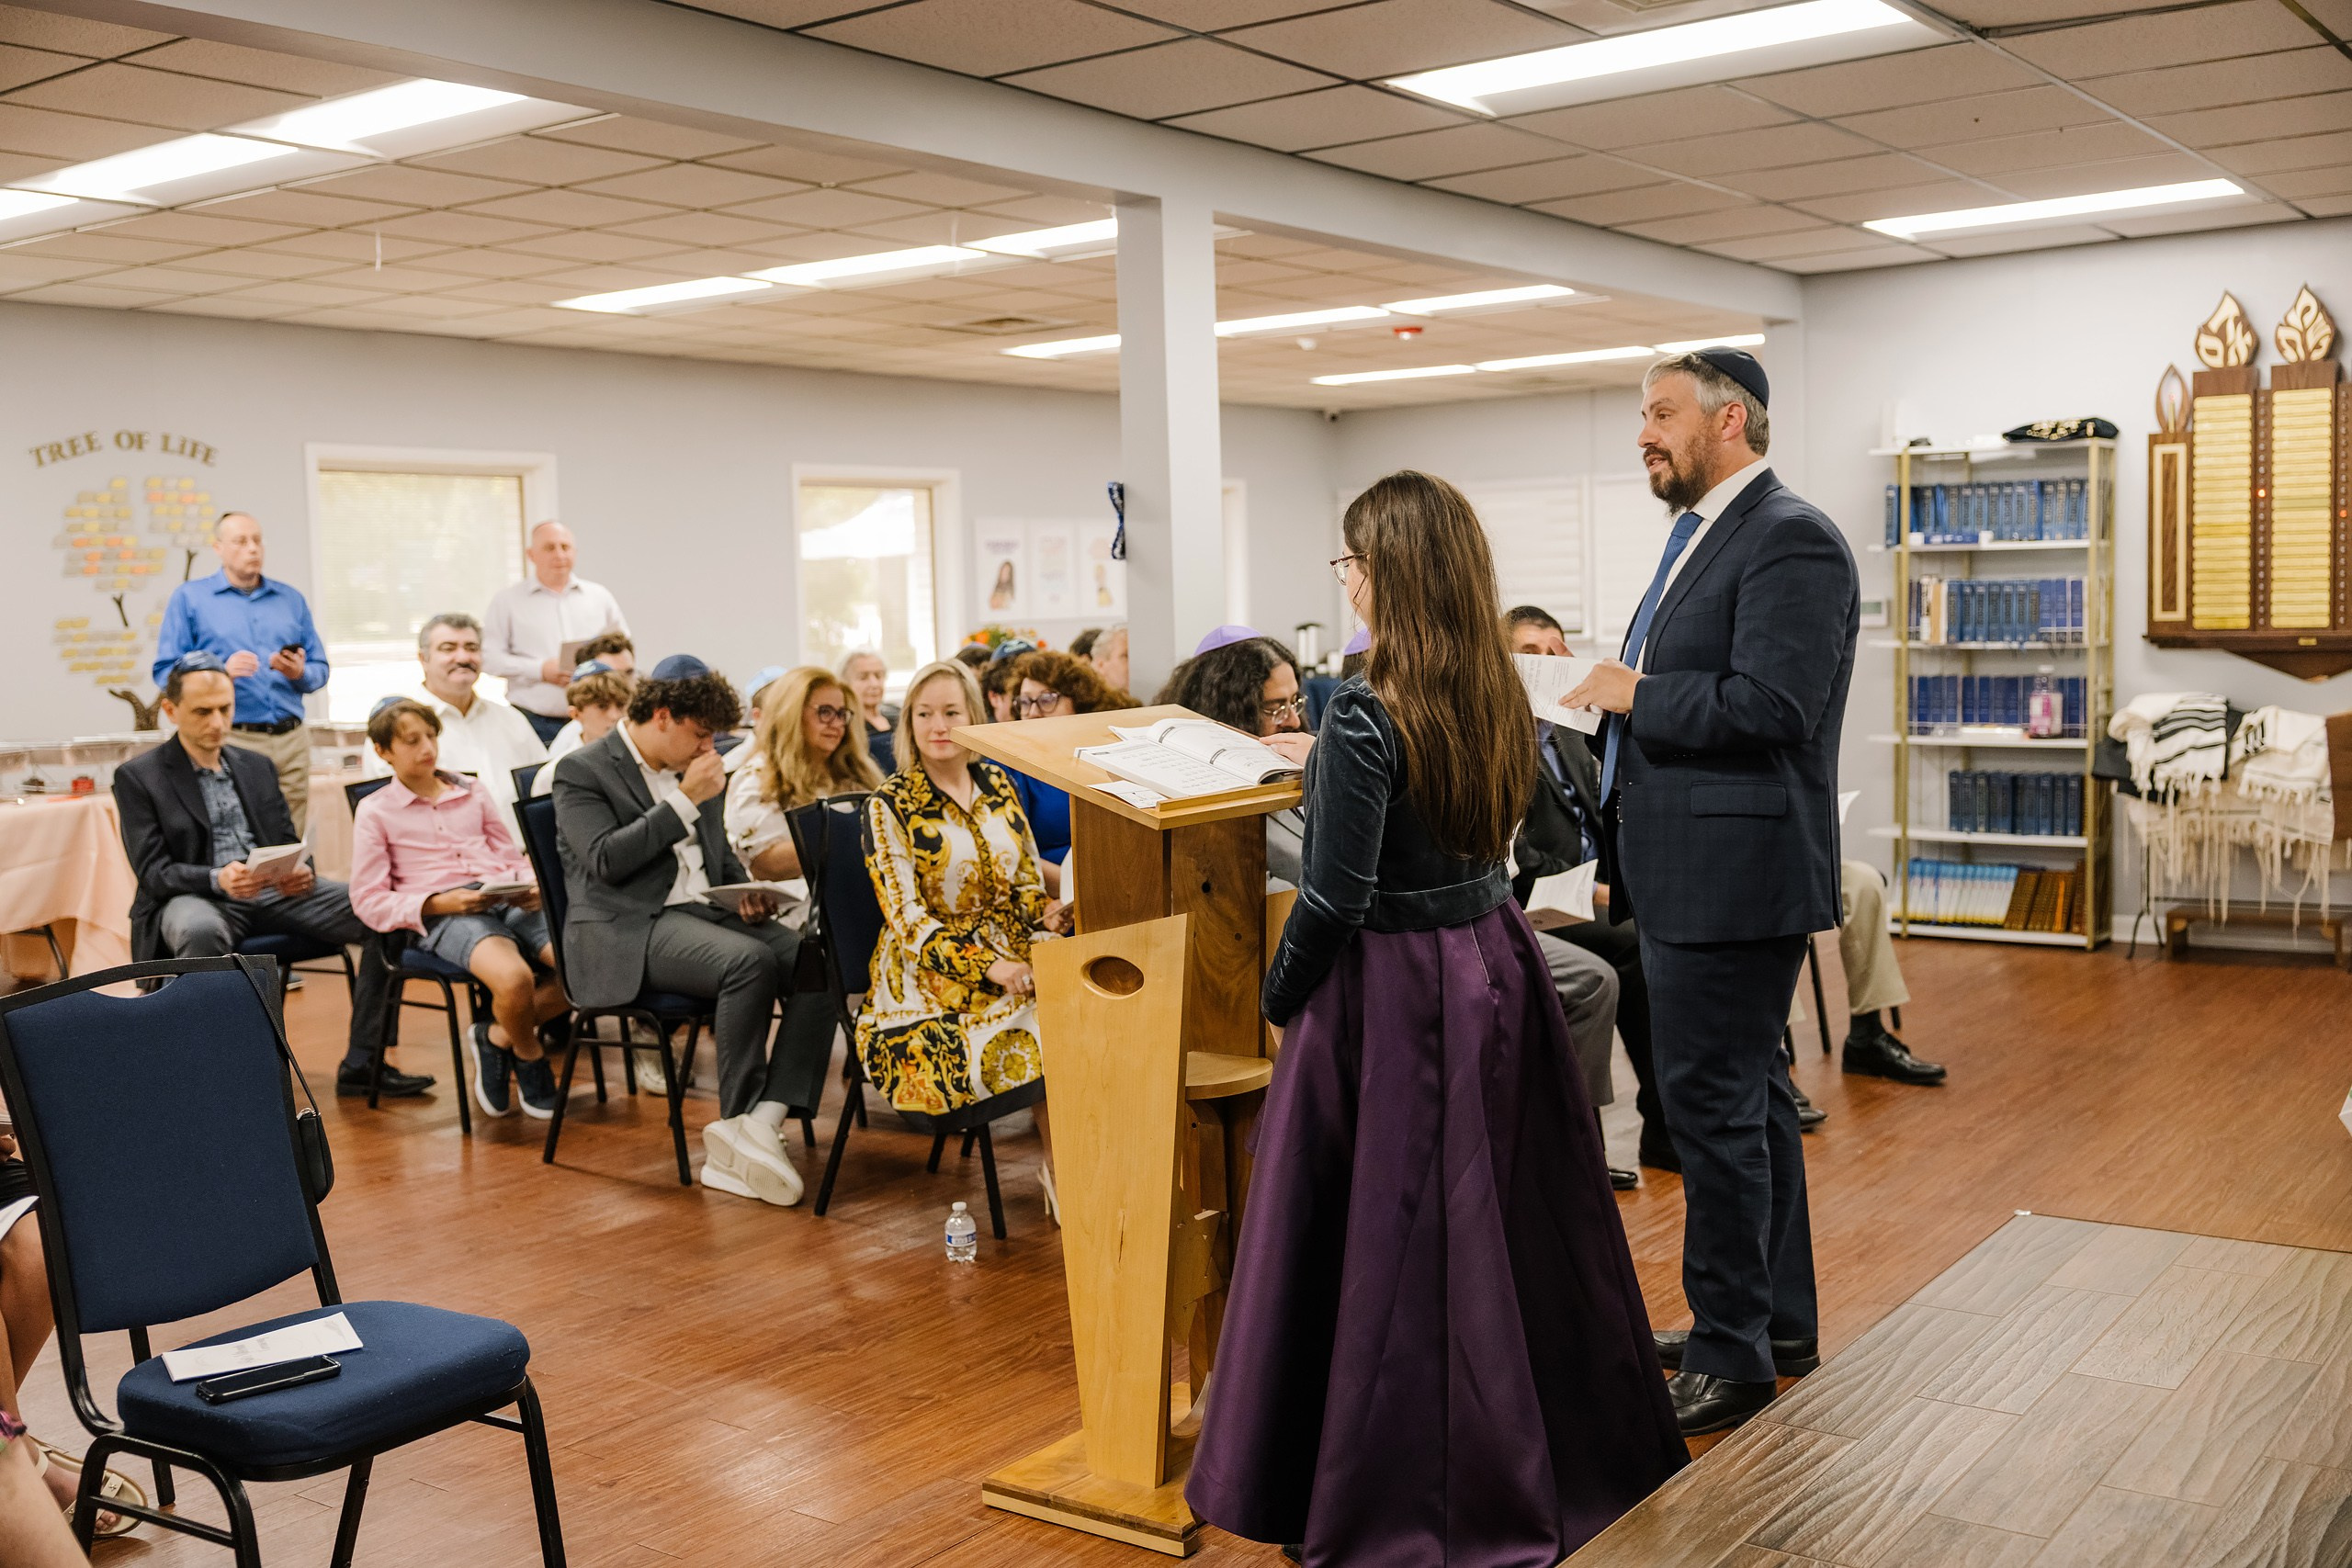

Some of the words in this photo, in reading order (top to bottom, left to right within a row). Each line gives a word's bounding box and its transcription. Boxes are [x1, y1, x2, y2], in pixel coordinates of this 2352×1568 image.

[29, 431, 102, 468] TREE
[114, 429, 151, 451] OF
[161, 432, 220, 467] LIFE
